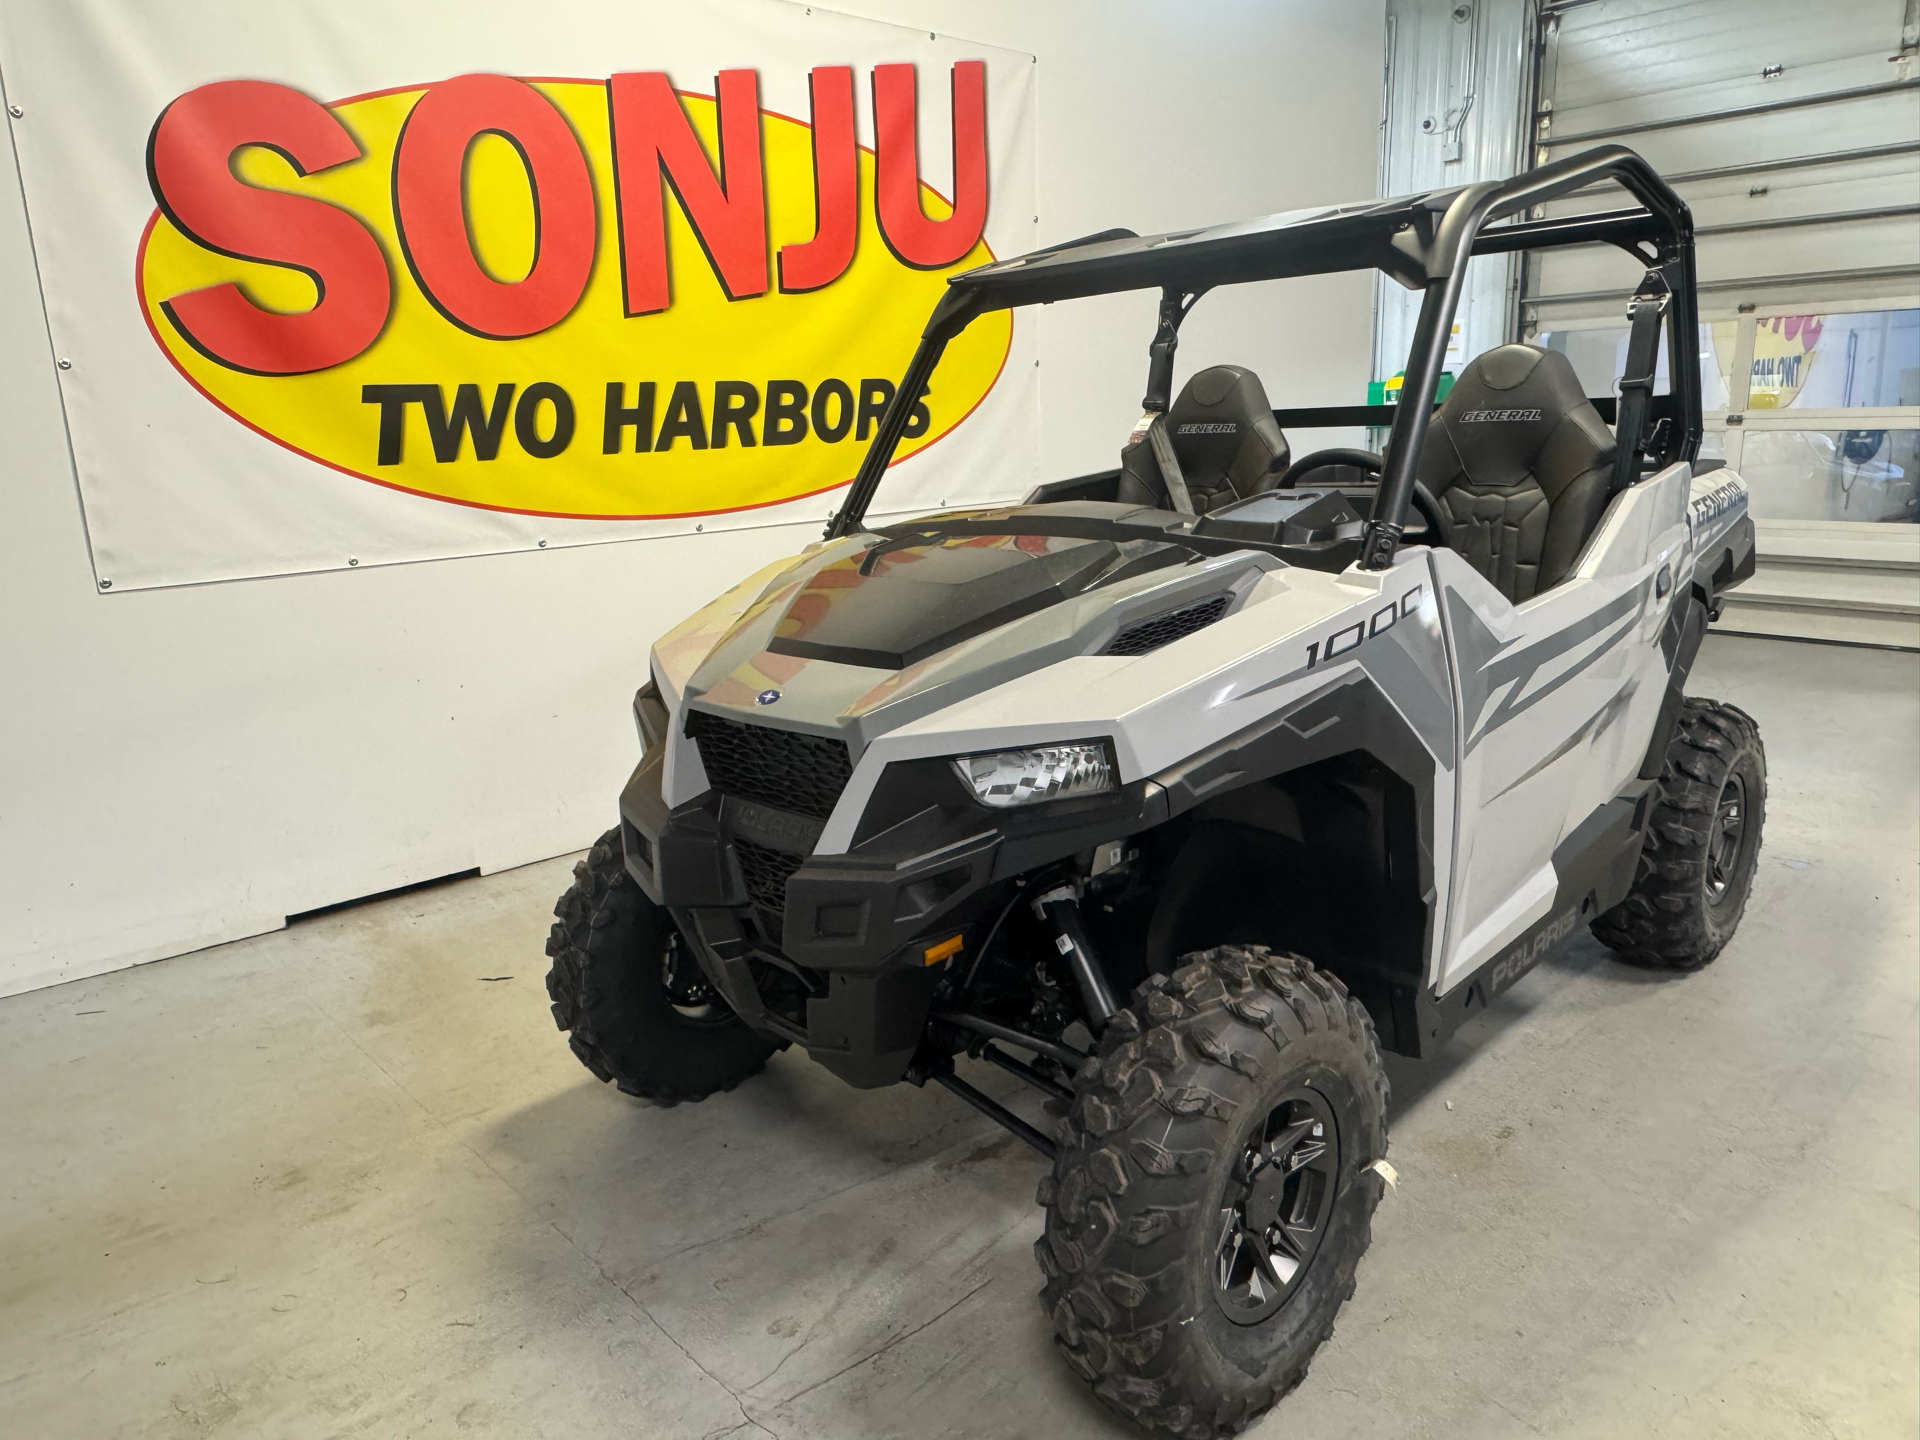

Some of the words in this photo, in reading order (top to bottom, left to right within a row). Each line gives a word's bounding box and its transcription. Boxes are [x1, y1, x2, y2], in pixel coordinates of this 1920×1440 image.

[147, 60, 988, 376] SONJU
[361, 381, 576, 466] TWO
[1177, 423, 1236, 434] GENERAL
[1459, 409, 1541, 422] GENERAL
[1491, 905, 1577, 992] POLARIS
